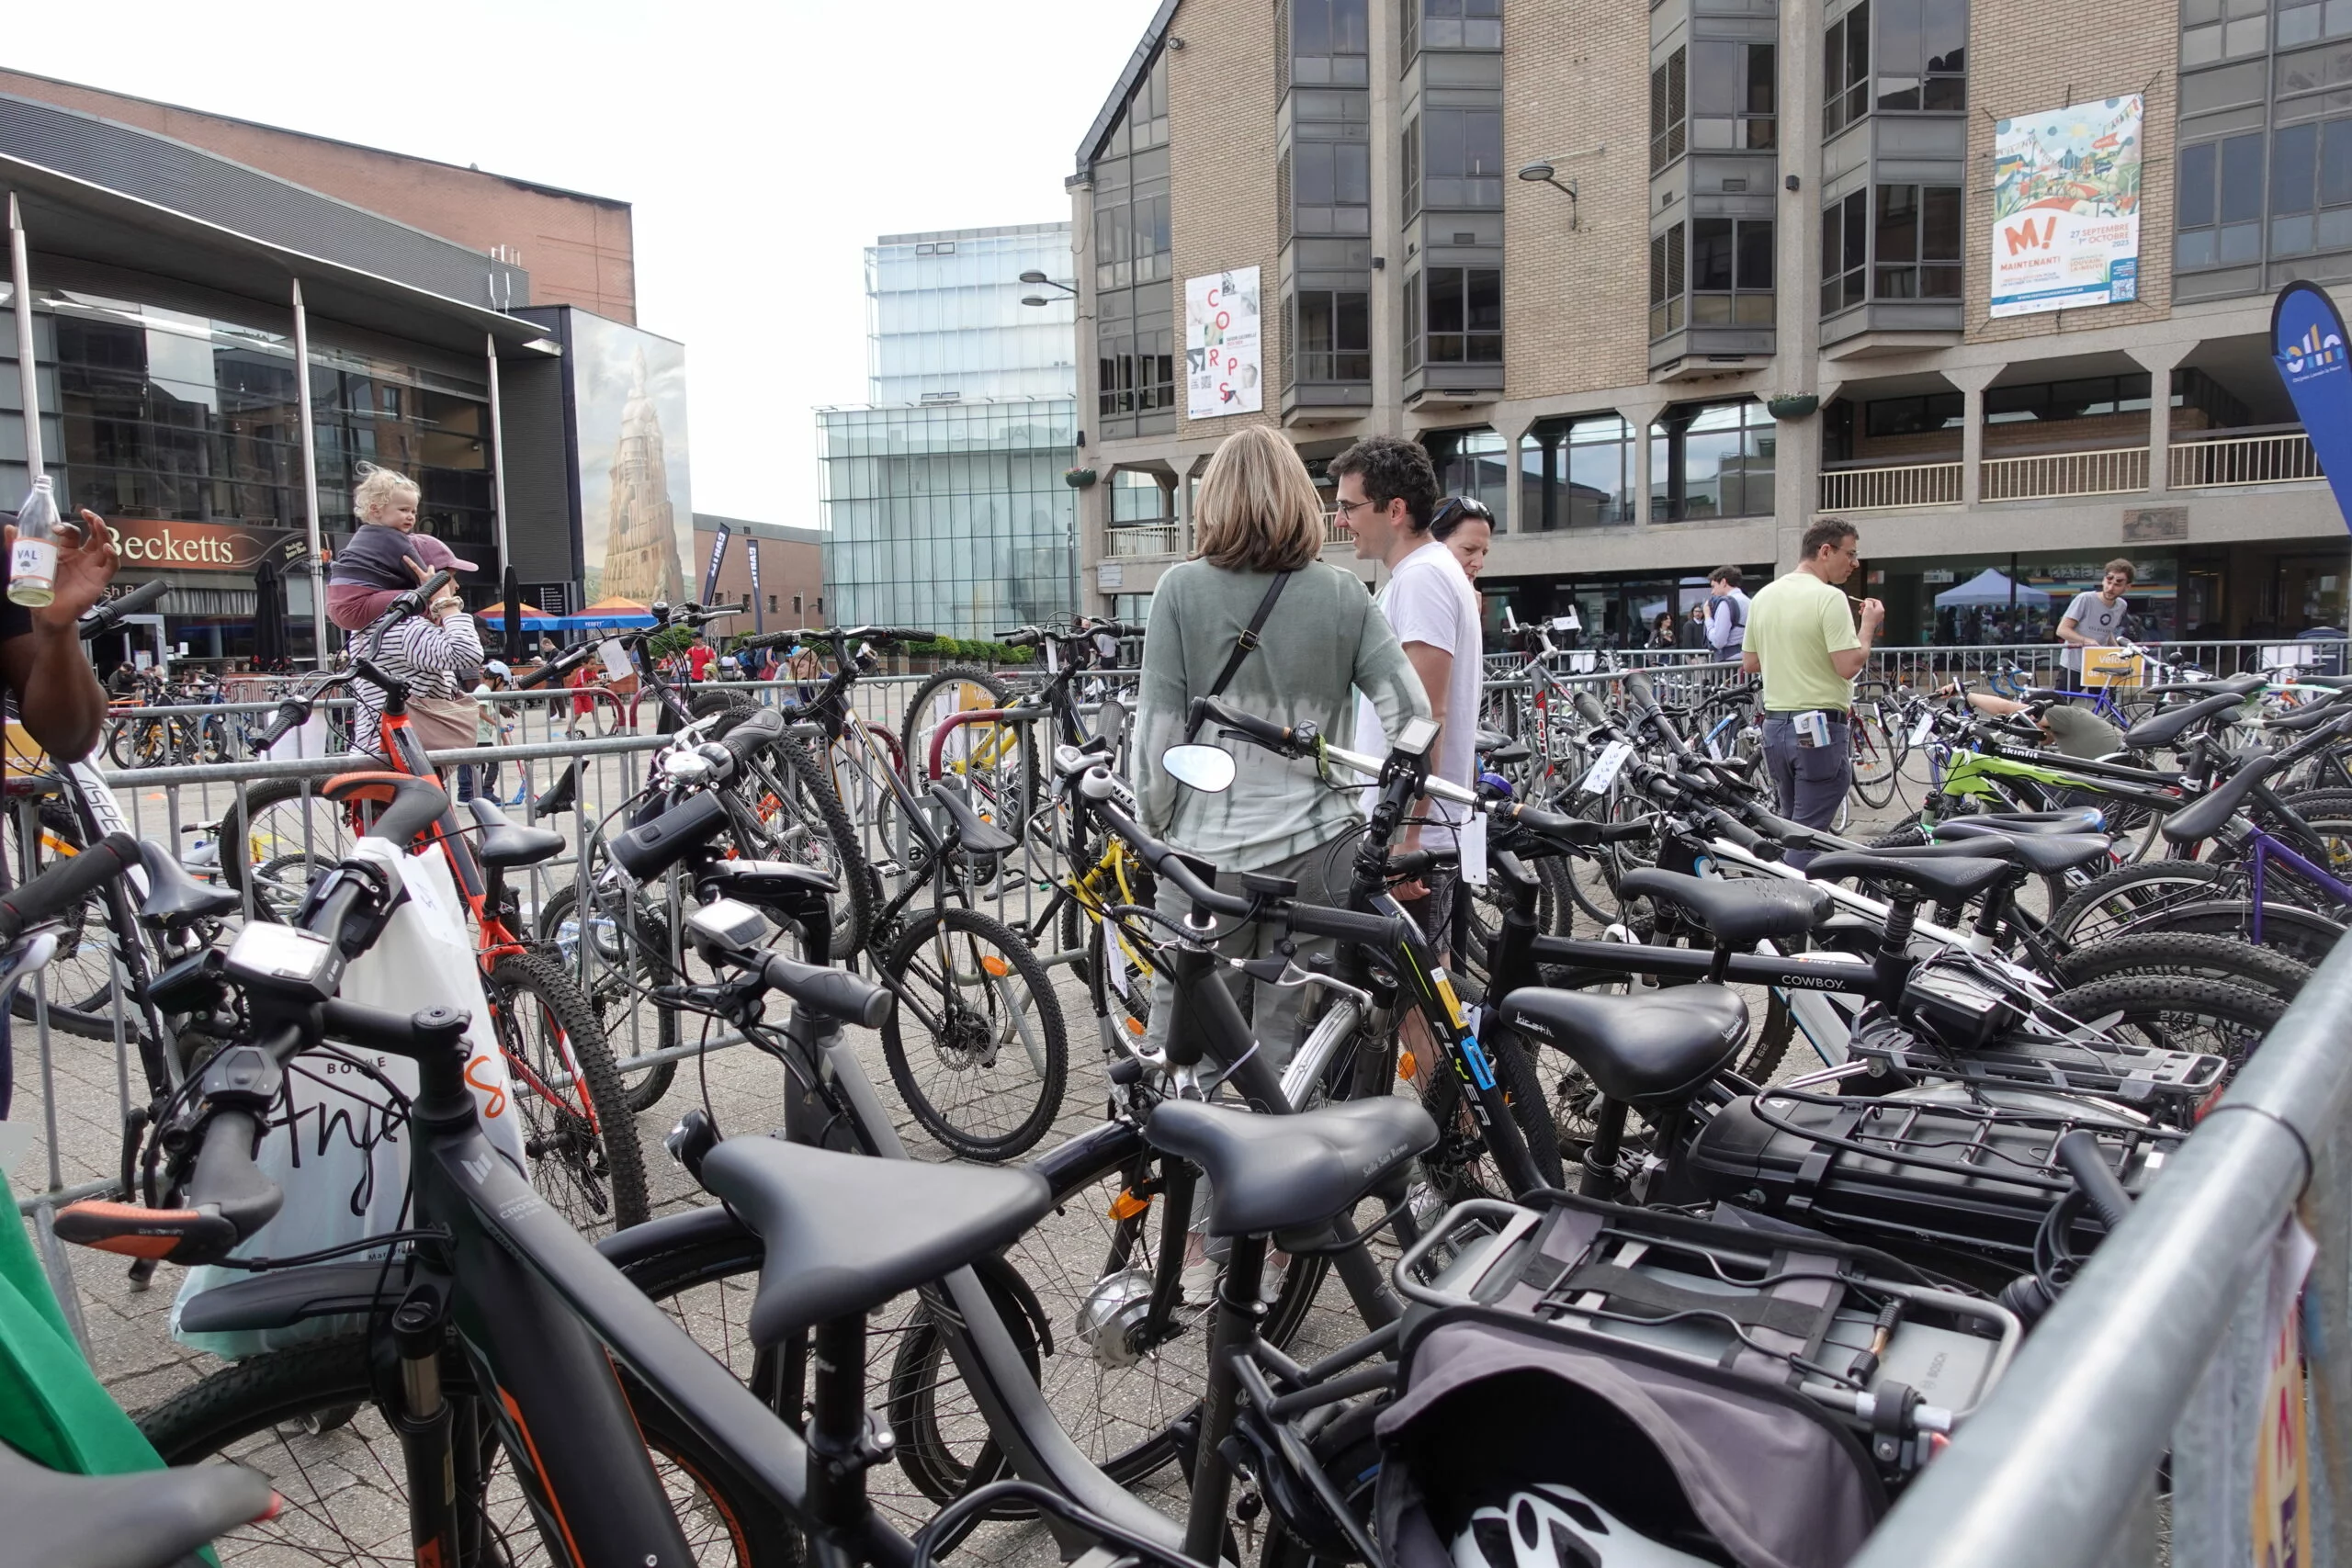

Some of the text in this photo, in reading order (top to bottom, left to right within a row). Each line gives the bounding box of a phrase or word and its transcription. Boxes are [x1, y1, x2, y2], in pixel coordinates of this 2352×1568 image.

[2005, 217, 2057, 256] M!
[2070, 223, 2130, 239] 27 SEPTEMBRE
[2088, 231, 2129, 244] OCTOBRE
[17, 549, 39, 560] VAL
[1536, 707, 1550, 761] SCOTT
[2000, 746, 2040, 760] skinfit
[2159, 1010, 2194, 1023] 27.5
[1433, 1021, 1491, 1127] FLYER
[1363, 1143, 1408, 1179] Selle San Remo
[499, 1197, 543, 1220] CROSS
[1927, 1351, 1949, 1378] BOSCH
